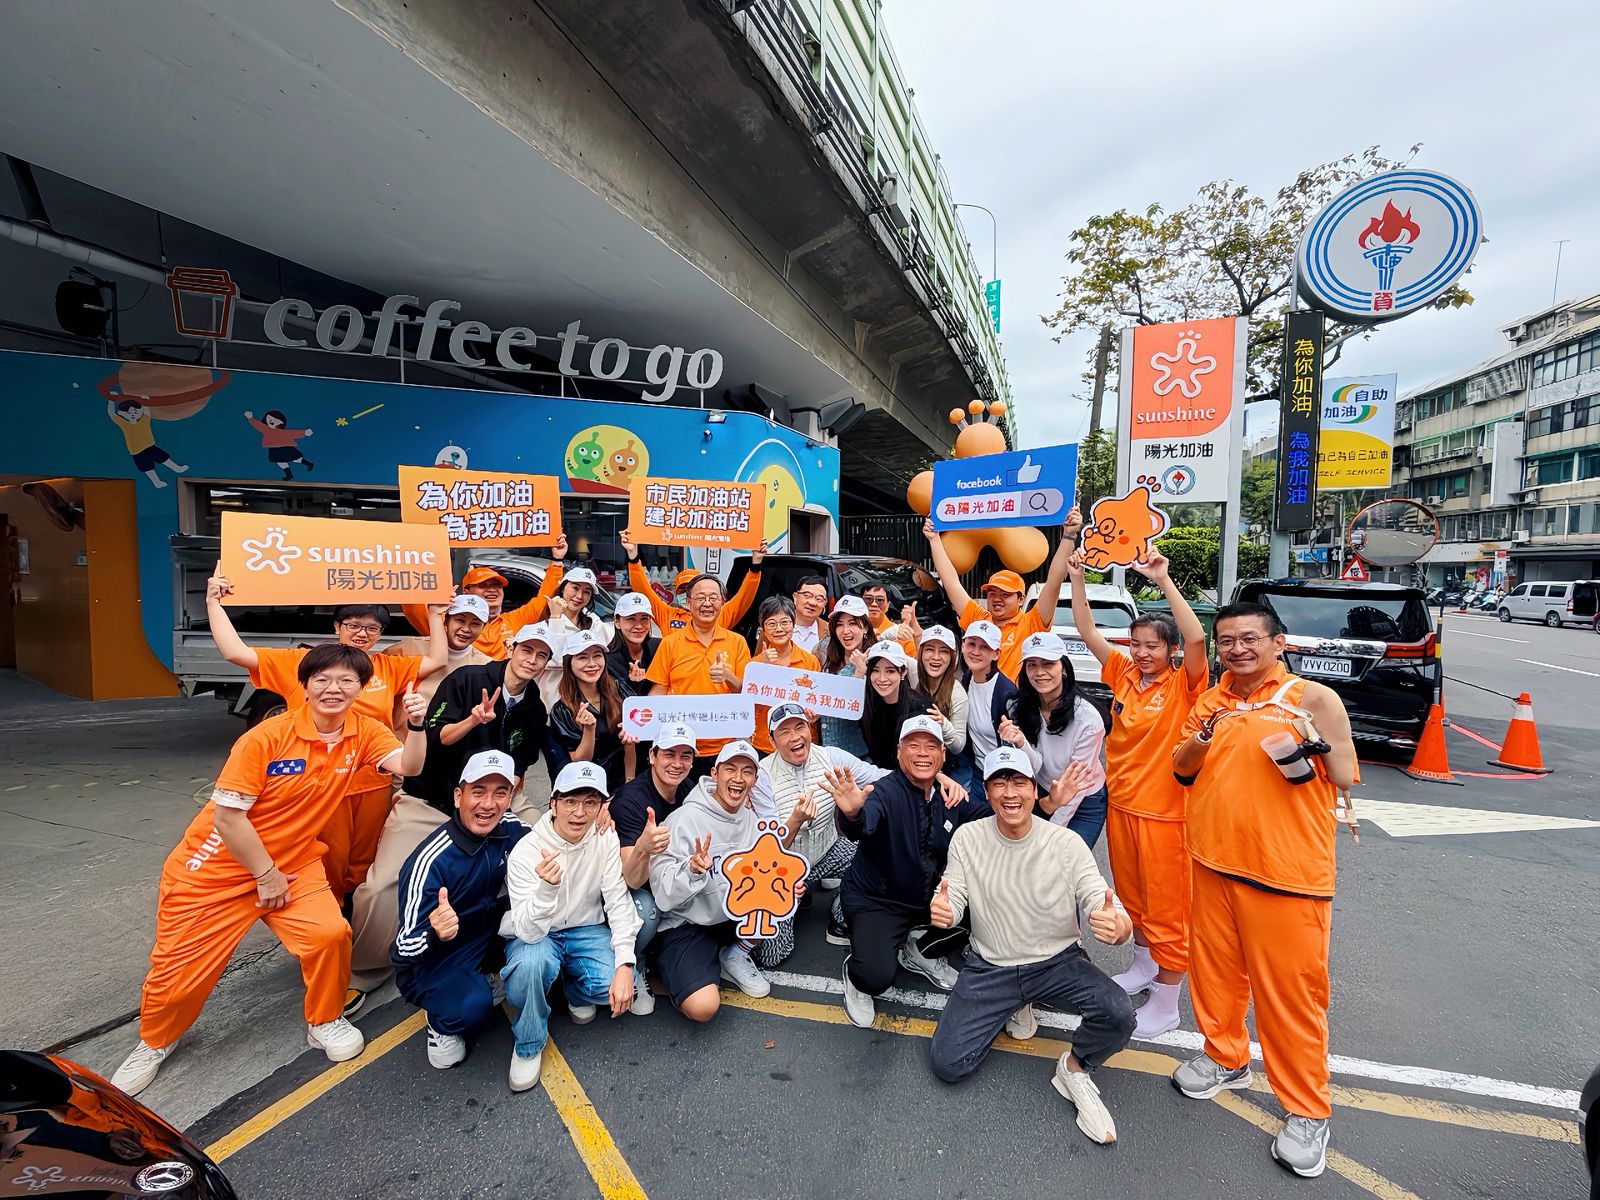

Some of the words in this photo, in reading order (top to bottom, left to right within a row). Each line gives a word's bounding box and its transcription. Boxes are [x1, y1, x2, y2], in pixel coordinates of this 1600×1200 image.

[264, 295, 537, 370] coffee
[557, 320, 630, 380] to
[641, 344, 723, 402] go
[1355, 388, 1388, 402] 自助
[1136, 406, 1216, 424] sunshine
[1324, 405, 1357, 418] 加油
[1144, 441, 1214, 460] 陽光加油
[1286, 431, 1310, 505] 為我加油
[1346, 468, 1386, 476] SERVICE
[956, 475, 1002, 490] facebook
[416, 480, 533, 511] 為你加油
[646, 483, 751, 510] 市民加油站
[944, 498, 1015, 516] 為陽光加油
[439, 509, 550, 541] 為我加油
[644, 505, 750, 533] 建北加油站
[307, 544, 436, 566] sunshine
[327, 568, 438, 590] 陽光加油
[746, 682, 801, 702] 為你加油
[805, 693, 861, 712] 為我加油
